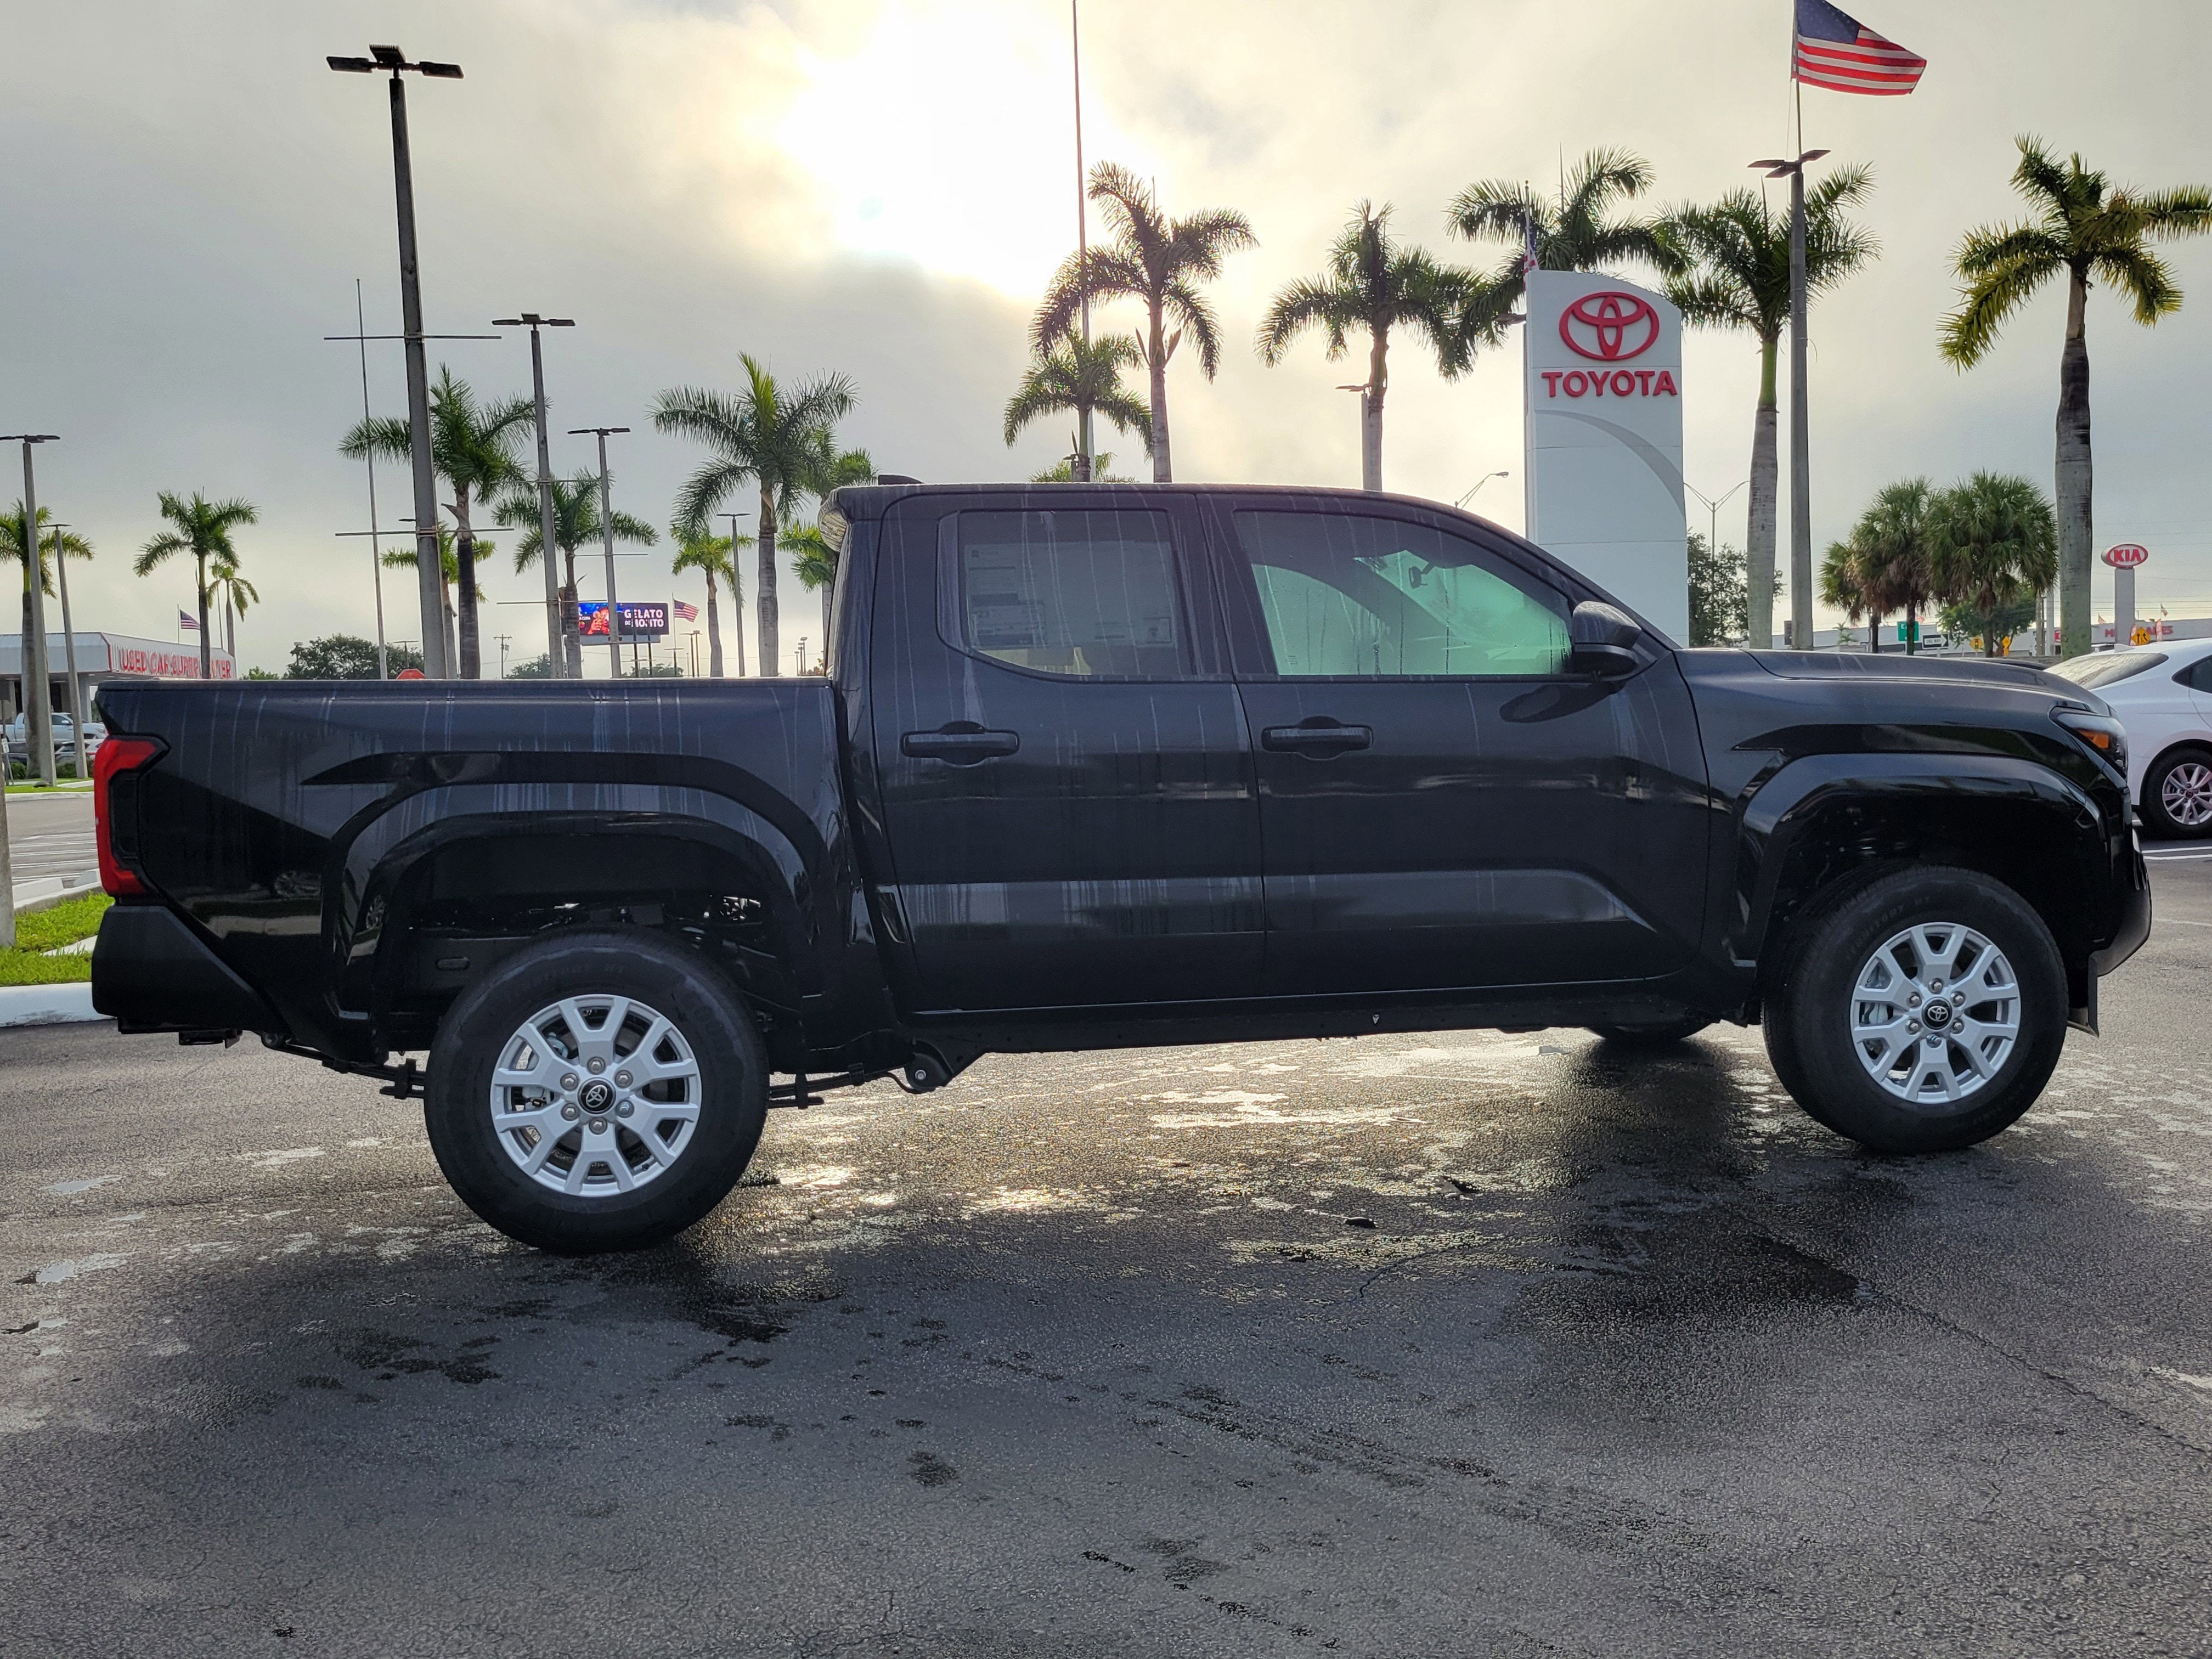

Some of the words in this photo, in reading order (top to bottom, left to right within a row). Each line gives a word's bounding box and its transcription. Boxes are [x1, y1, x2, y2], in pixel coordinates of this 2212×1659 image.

[1541, 370, 1678, 397] TOYOTA
[2114, 549, 2142, 562] KIA
[624, 609, 663, 619] GELATO
[121, 648, 147, 672] USED
[150, 652, 169, 674] CAR
[171, 654, 198, 678] SUPER
